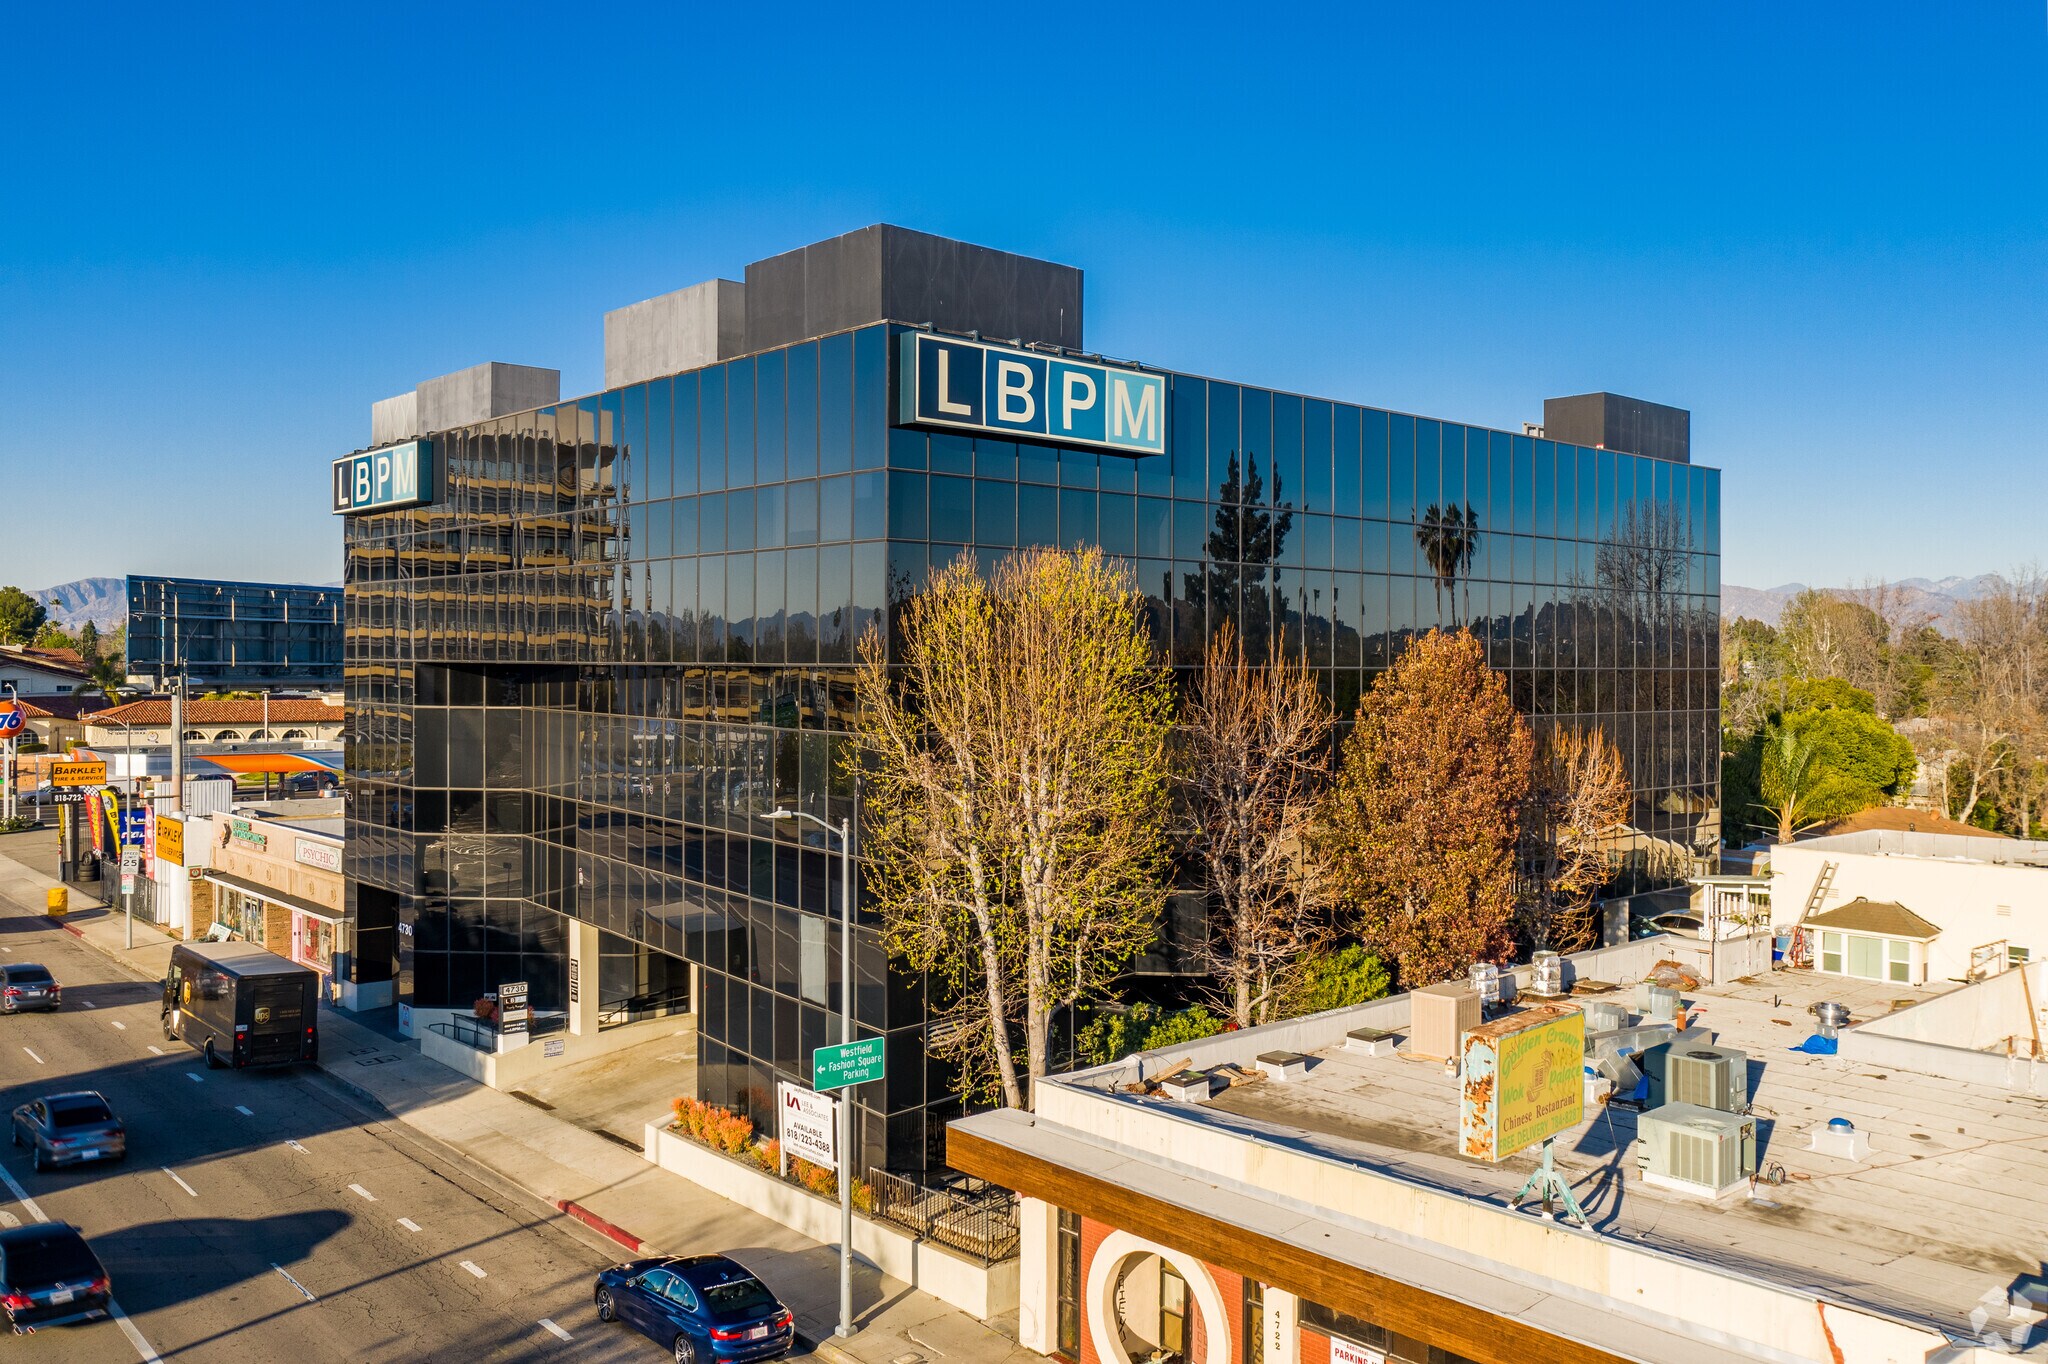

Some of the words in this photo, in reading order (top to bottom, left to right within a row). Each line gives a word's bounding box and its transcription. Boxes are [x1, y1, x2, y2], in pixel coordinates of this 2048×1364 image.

[938, 349, 1156, 442] LBPM
[338, 450, 414, 506] LBPM
[54, 766, 104, 775] BARKLEY
[303, 847, 335, 865] PSYCHIC
[398, 922, 413, 936] 4730
[505, 985, 525, 993] 4730
[840, 1044, 873, 1058] Westfield
[1502, 1035, 1542, 1080] Golden
[1546, 1027, 1580, 1050] Crown
[828, 1059, 855, 1072] Fashion
[857, 1055, 882, 1067] Square
[843, 1067, 869, 1080] Parking
[1503, 1084, 1524, 1105] Wok
[802, 1107, 829, 1122] ASSOCIATES
[1503, 1111, 1533, 1132] Chinese
[1535, 1092, 1575, 1118] Restaurant
[793, 1121, 823, 1139] AVAILABLE
[1499, 1133, 1515, 1154] FREE
[1517, 1120, 1549, 1145] DELIVERY
[786, 1128, 831, 1154] 818/223-4388
[1346, 1343, 1369, 1356] Additional
